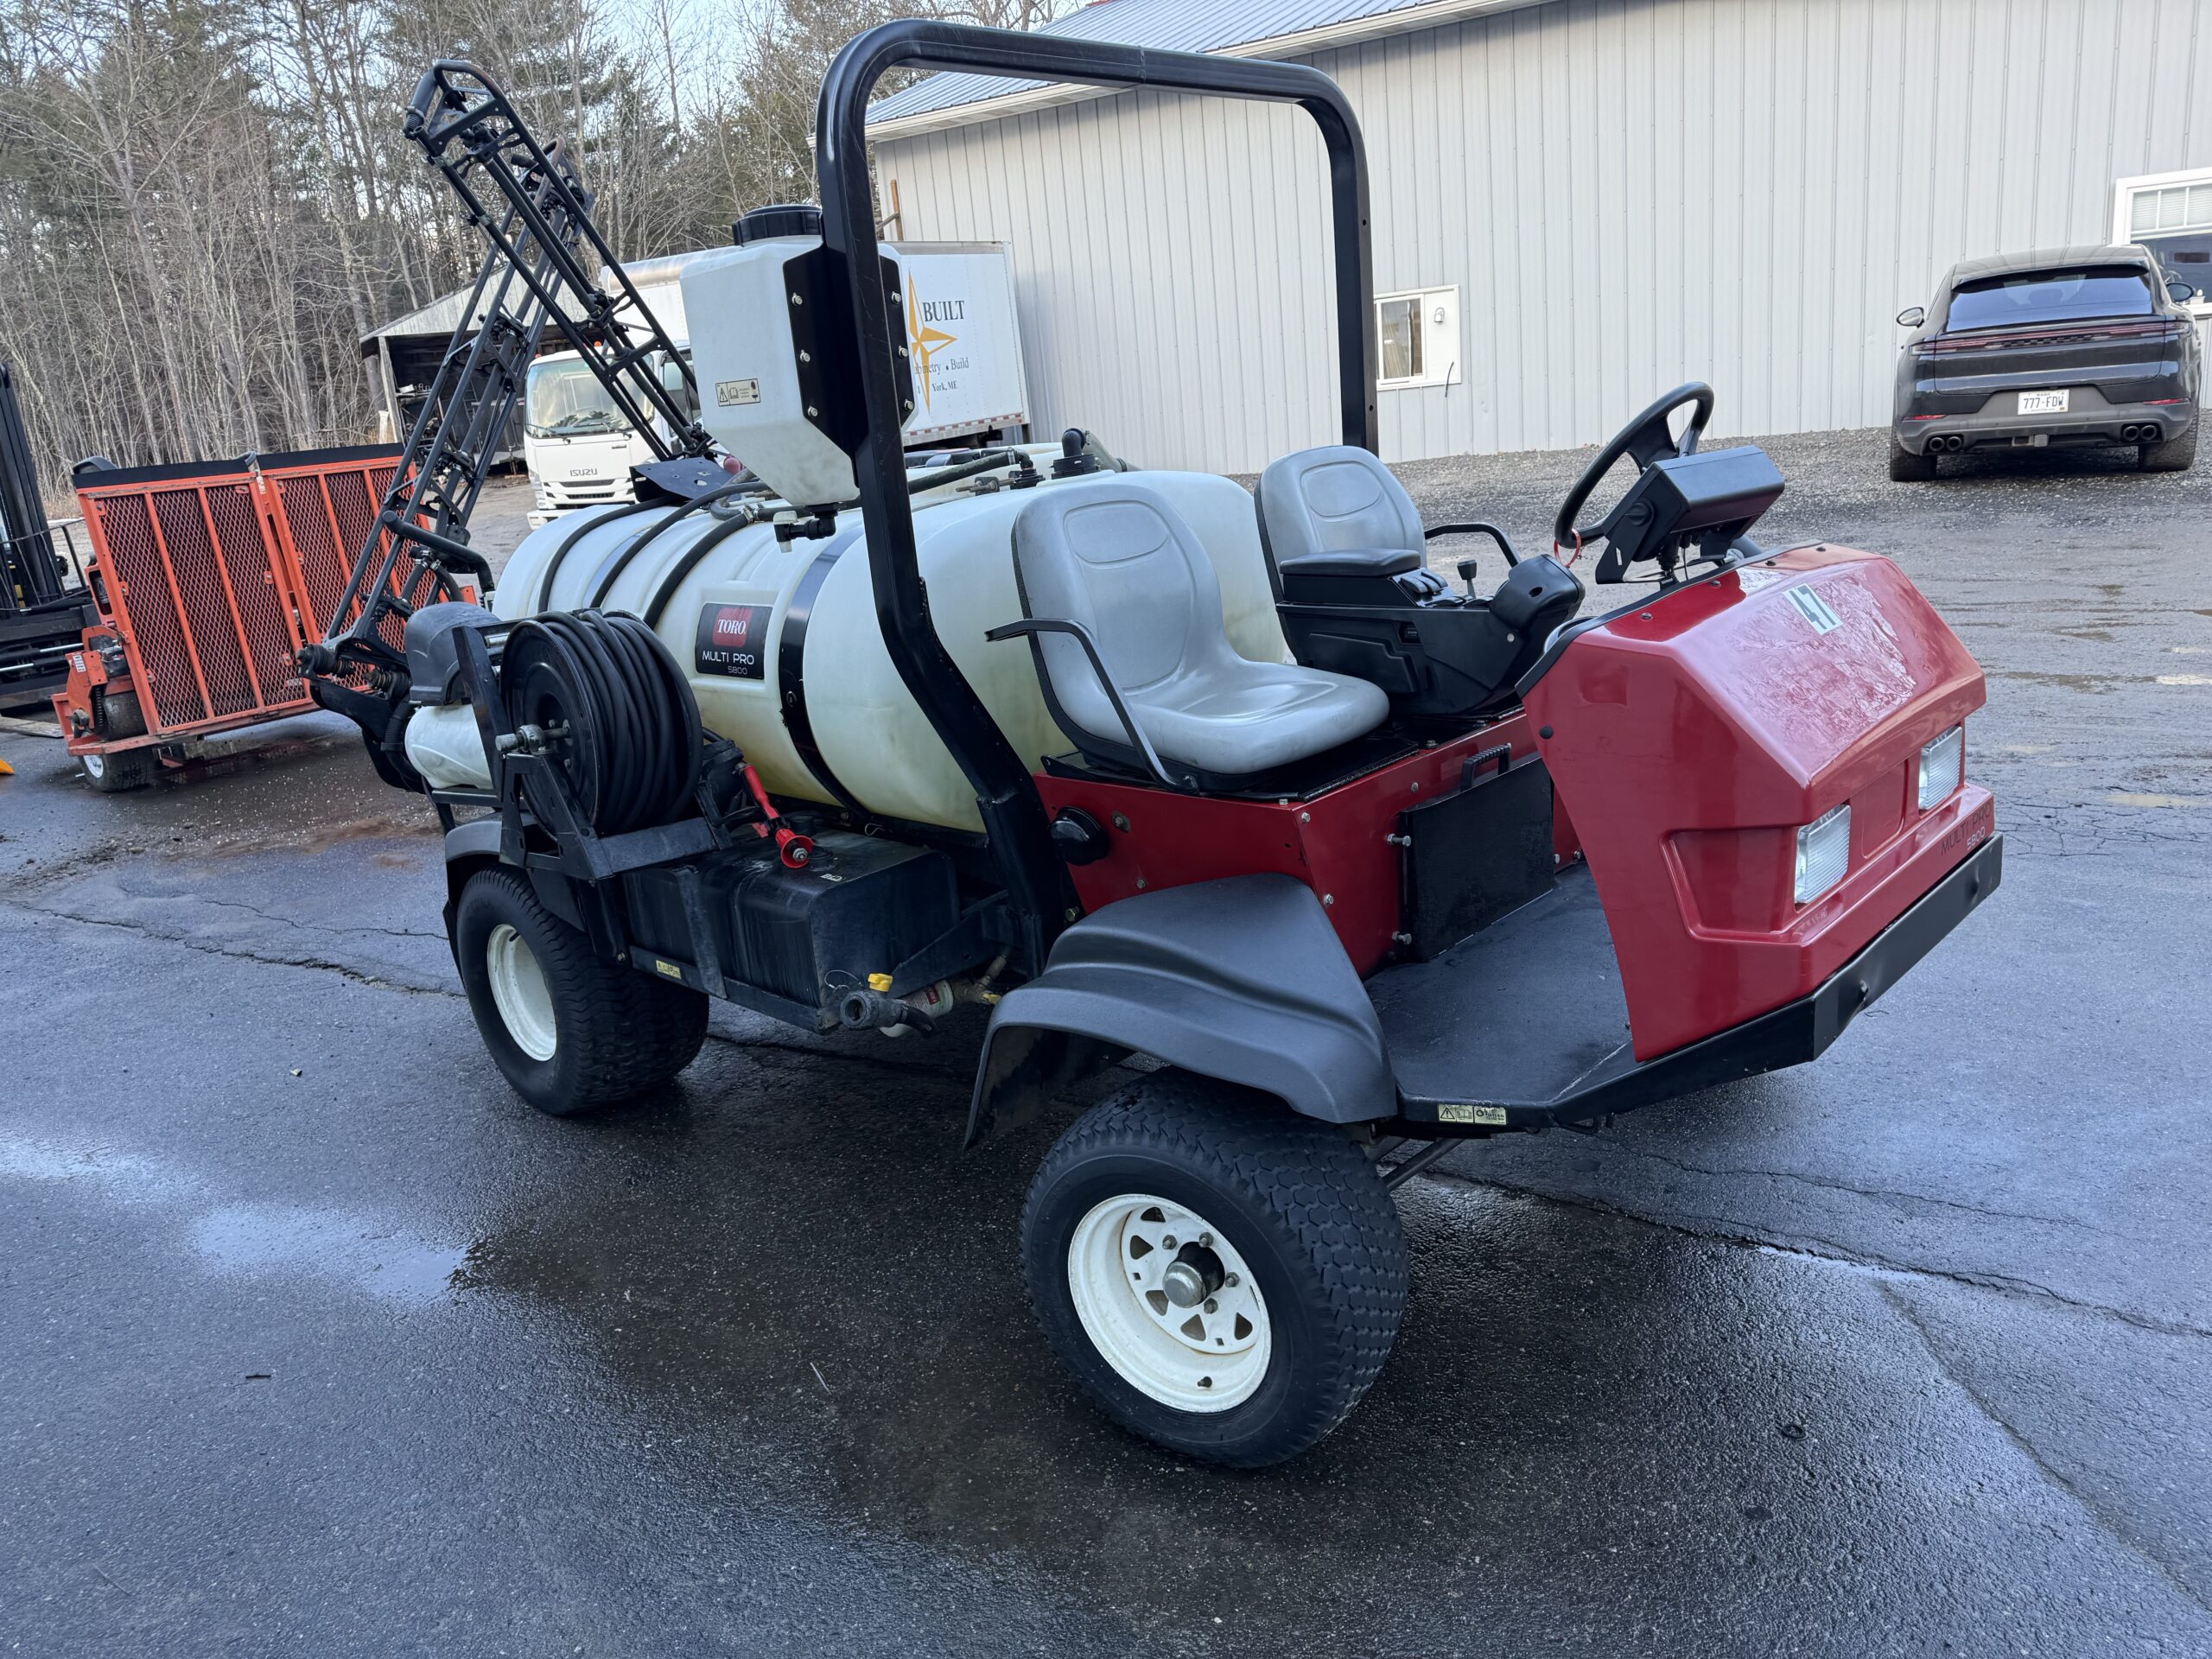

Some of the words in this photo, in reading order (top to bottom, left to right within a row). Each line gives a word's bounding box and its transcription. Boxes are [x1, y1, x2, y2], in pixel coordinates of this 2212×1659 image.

[922, 300, 965, 322] BUILT
[950, 357, 969, 371] Build
[931, 383, 948, 392] York,
[569, 467, 598, 477] ISUZU
[1789, 584, 1837, 630] 47
[717, 619, 747, 635] TORO
[702, 650, 729, 664] MULTI
[733, 652, 755, 665] PRO
[727, 665, 748, 676] 5800
[1941, 820, 1969, 856] MULTI
[1973, 801, 1991, 830] PRO
[1967, 826, 1986, 851] 5800
